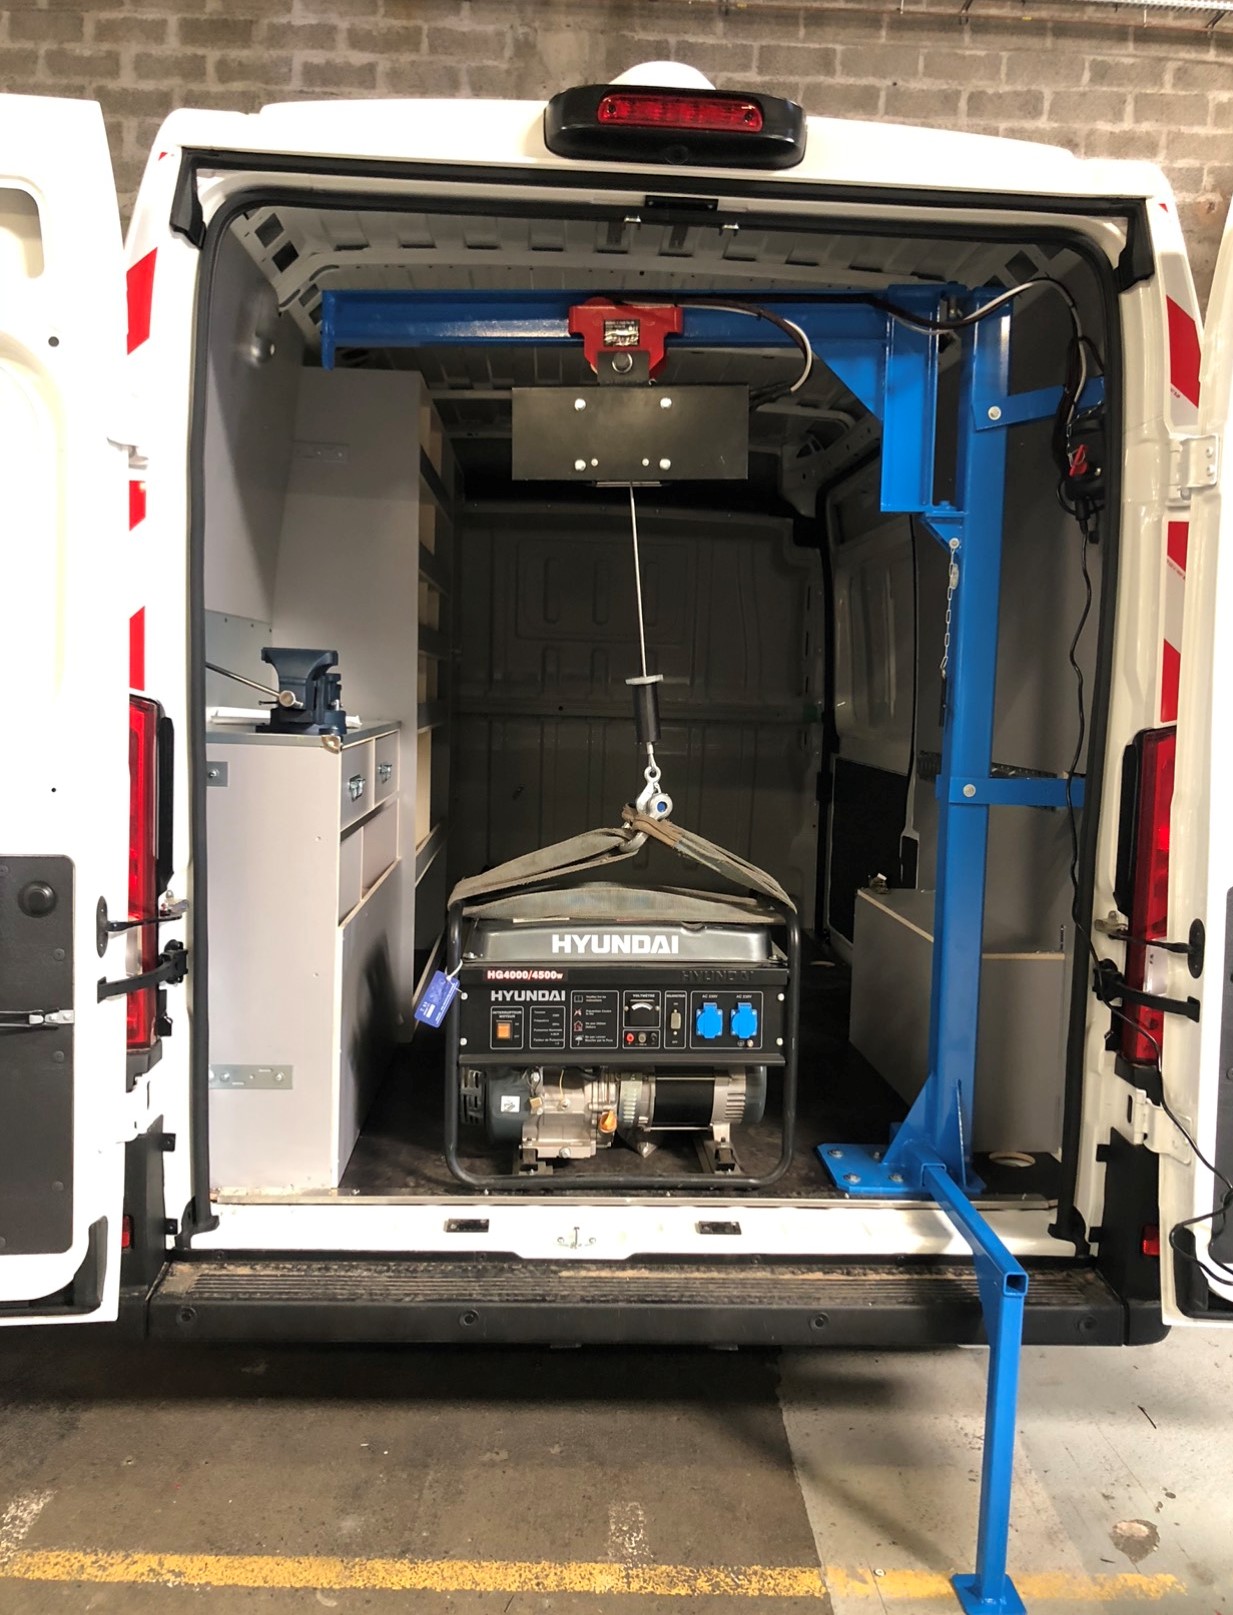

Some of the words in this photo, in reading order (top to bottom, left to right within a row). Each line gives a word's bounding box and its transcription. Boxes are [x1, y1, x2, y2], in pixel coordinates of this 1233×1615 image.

[551, 934, 679, 954] HYUNDAI
[486, 970, 564, 980] HG4000/4500w
[490, 990, 566, 1001] HYUNDAI
